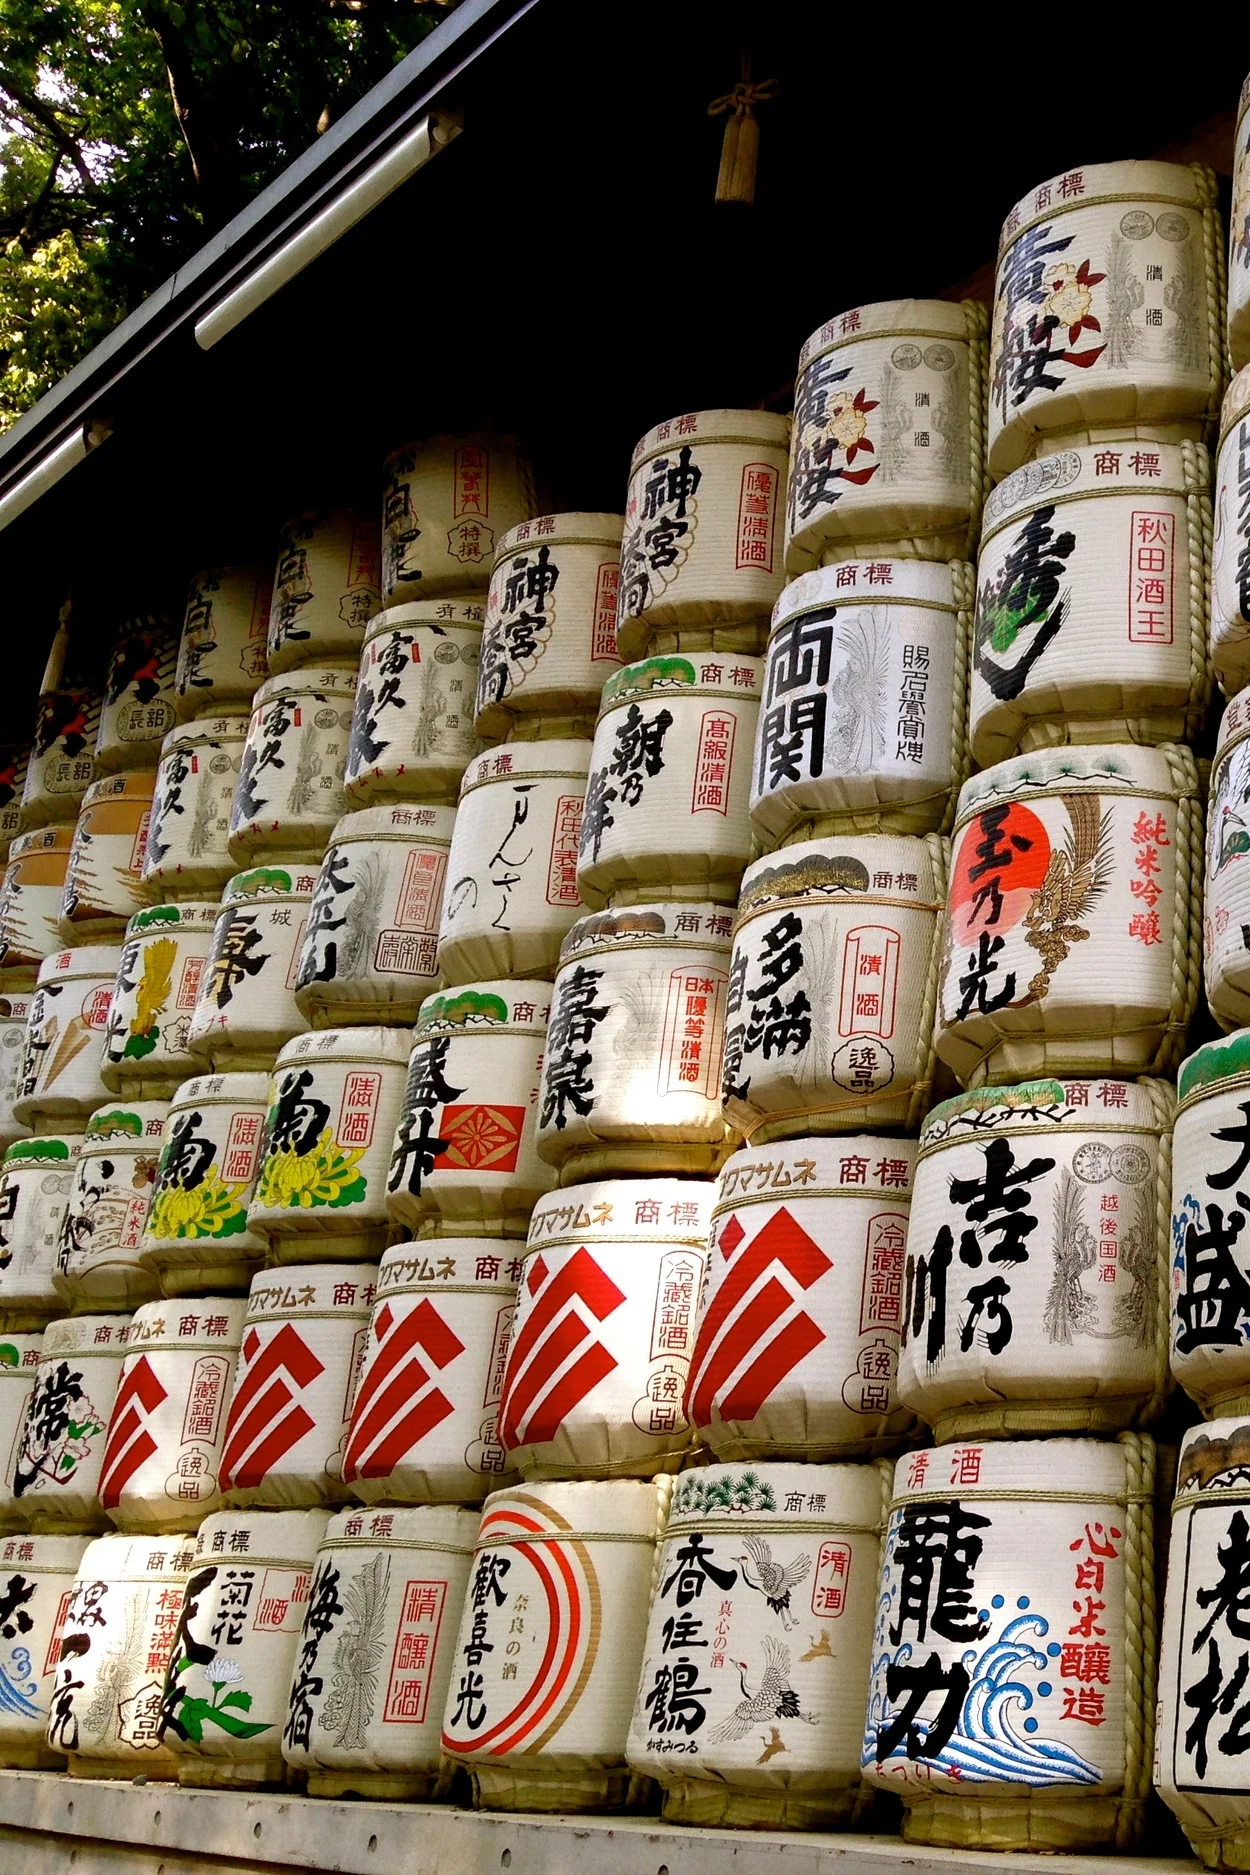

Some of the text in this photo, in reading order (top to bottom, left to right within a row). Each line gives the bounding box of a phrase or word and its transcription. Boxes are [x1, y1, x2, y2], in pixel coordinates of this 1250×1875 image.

[1145, 264, 1164, 327] 清酒
[914, 391, 931, 448] 清酒
[1093, 450, 1163, 478] 商標
[640, 444, 703, 571] 神宮
[458, 525, 482, 558] 特撰
[516, 516, 557, 543] 商標
[835, 562, 894, 589] 商標
[1135, 516, 1168, 638] 秋田酒王
[500, 544, 560, 662] 神宮
[699, 662, 757, 689] 商標
[758, 606, 838, 797] 両関
[477, 753, 514, 780] 商標
[390, 808, 438, 827] 商標
[872, 870, 919, 892] 商標
[269, 908, 293, 927] 城
[673, 911, 734, 938] 商標
[954, 802, 1034, 1022] 玉乃光
[684, 976, 715, 995] 日本
[856, 953, 884, 1018] 清酒
[295, 1034, 340, 1054] 商標
[848, 1046, 881, 1088] 逸品
[341, 1076, 376, 1143] 清酒
[1062, 1082, 1129, 1109] 商標
[226, 1117, 259, 1179] 清酒
[838, 1154, 910, 1189] 商標
[634, 1198, 701, 1228] 商標
[1097, 1193, 1119, 1284] 越後国酒
[177, 1314, 230, 1338] 商標
[907, 1447, 984, 1490] 清酒
[783, 1490, 829, 1514] 商標
[211, 1529, 252, 1554] 商標
[344, 1514, 395, 1537] 商標
[146, 1550, 194, 1572] 商標
[815, 1548, 849, 1612] 清酒
[210, 1569, 255, 1647] 菊花
[501, 1593, 531, 1682] 奈良の酒
[645, 1533, 738, 1736] 香住鶴
[709, 1599, 733, 1669] 真心の酒
[875, 1499, 993, 1763] 龍力
[646, 1737, 700, 1755] かすみつる
